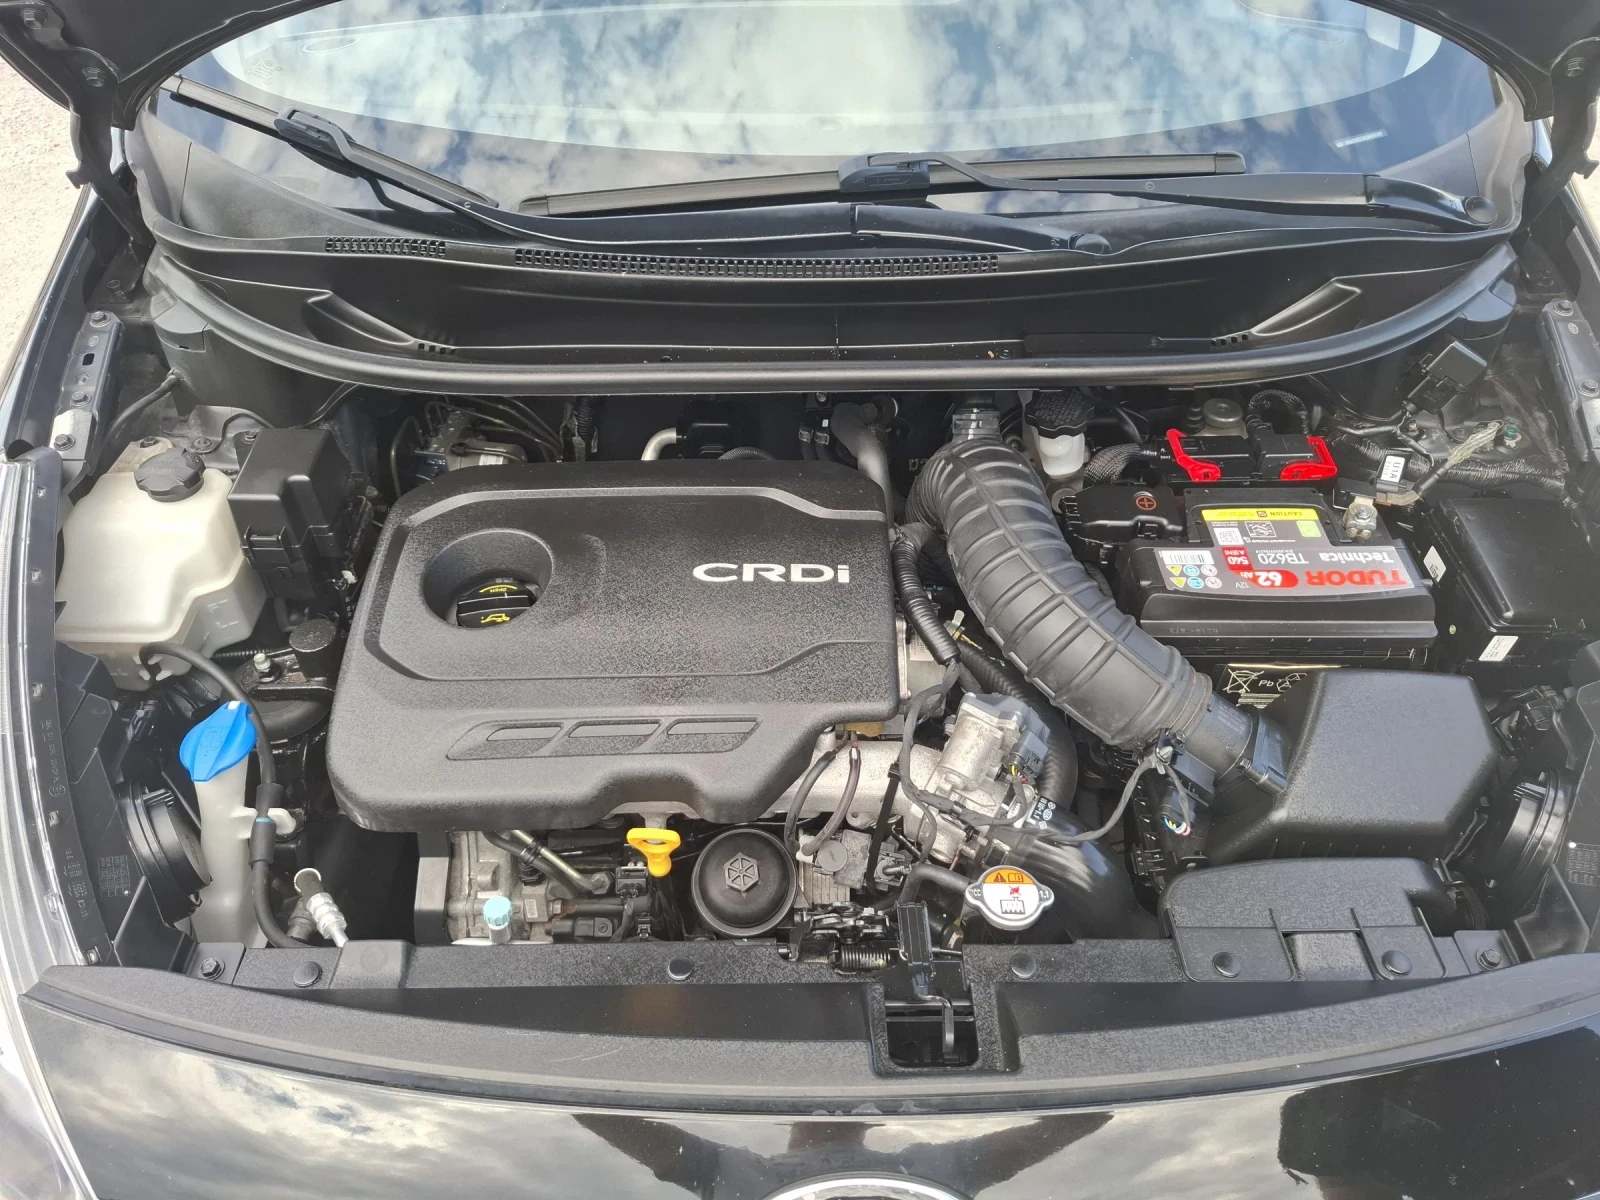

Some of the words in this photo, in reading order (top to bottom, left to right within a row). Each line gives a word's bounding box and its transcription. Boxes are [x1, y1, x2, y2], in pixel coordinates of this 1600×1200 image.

[1227, 556, 1249, 565] 540
[1257, 552, 1309, 564] TB620
[1319, 552, 1394, 564] Technica
[692, 562, 850, 583] CRDi
[1304, 569, 1407, 587] TUDOR
[1235, 581, 1249, 589] 12V
[1258, 679, 1274, 687] Pb
